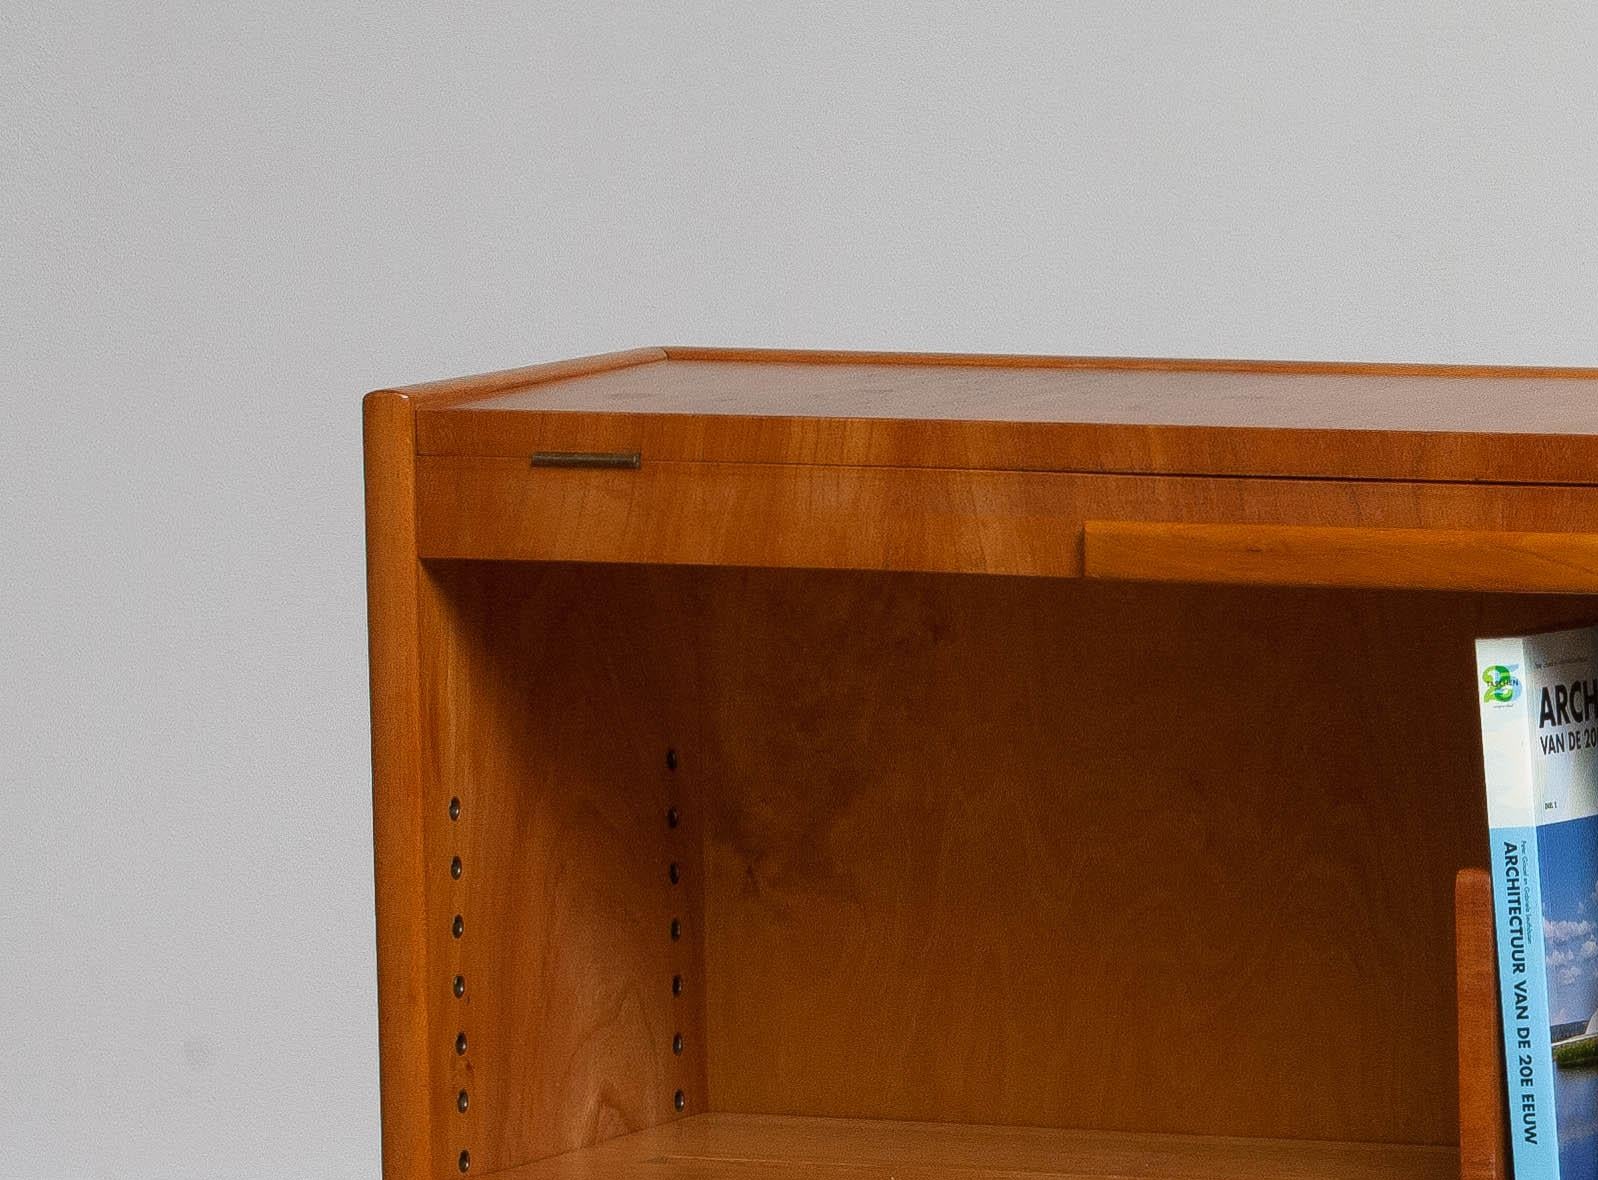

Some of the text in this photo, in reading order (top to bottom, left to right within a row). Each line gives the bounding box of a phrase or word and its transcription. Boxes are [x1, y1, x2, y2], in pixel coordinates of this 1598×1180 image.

[1540, 733, 1565, 755] VAN
[1568, 730, 1582, 751] DE
[1504, 841, 1526, 975] ARCHITECTUUR
[1514, 980, 1529, 1020] VAN
[1517, 1027, 1531, 1049] DE
[1519, 1054, 1533, 1087] 20E
[1522, 1094, 1538, 1145] EEUW
